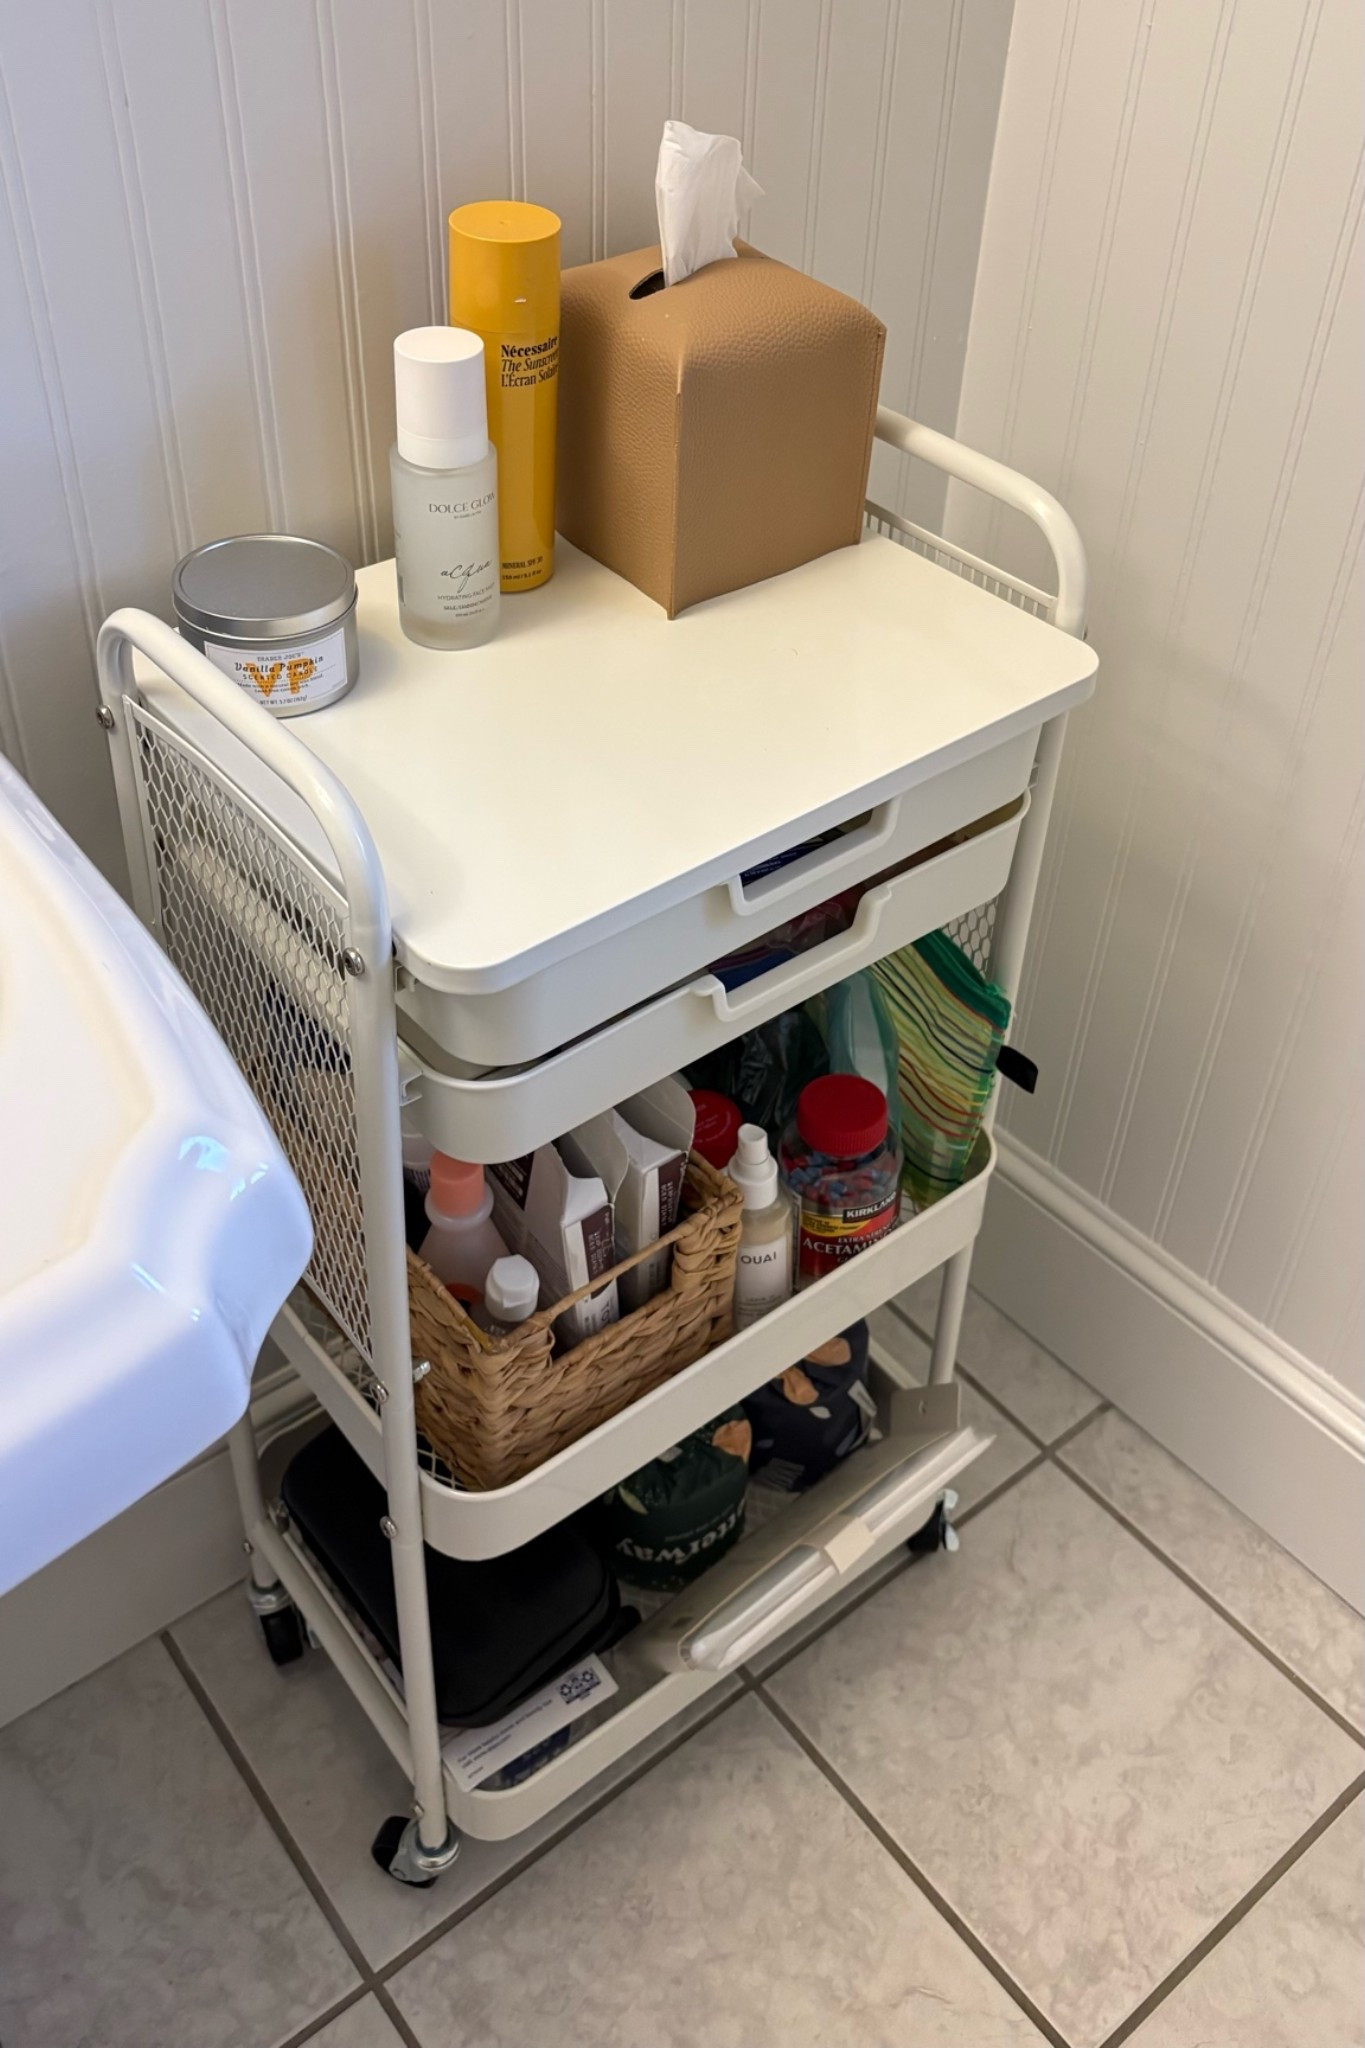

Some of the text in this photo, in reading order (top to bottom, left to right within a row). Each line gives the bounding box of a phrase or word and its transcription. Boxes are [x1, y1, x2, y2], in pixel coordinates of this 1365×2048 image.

[501, 358, 522, 372] The
[429, 502, 469, 514] DOLCE
[234, 655, 324, 673] Vanilla Pumpkin
[846, 1191, 897, 1218] KIRKLAND
[740, 1251, 777, 1265] OUAI
